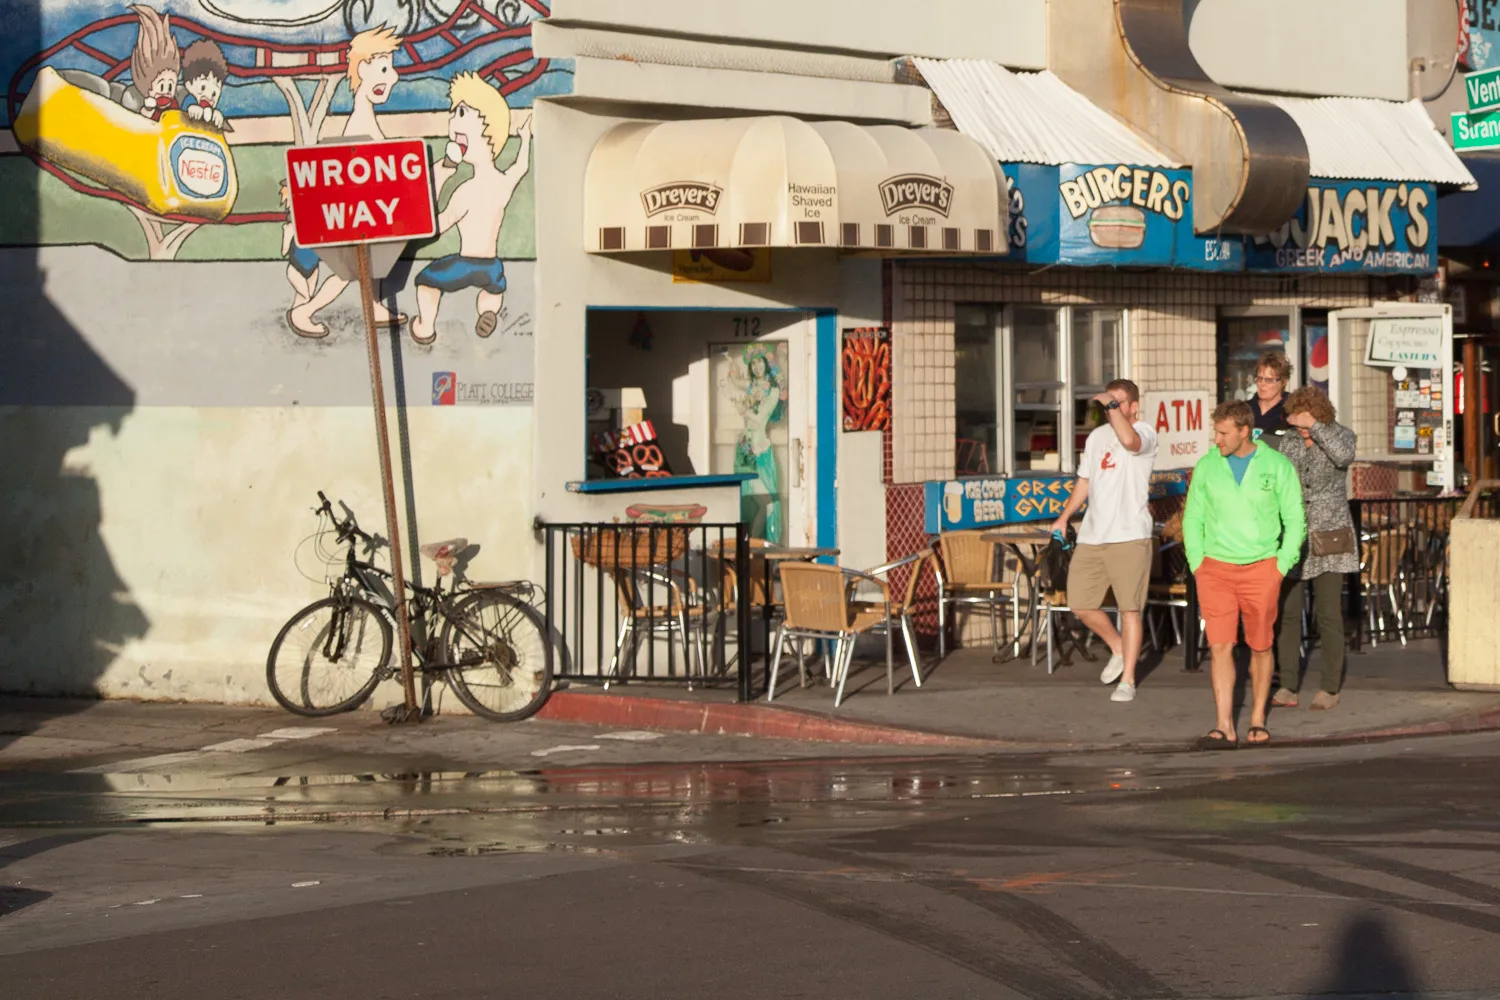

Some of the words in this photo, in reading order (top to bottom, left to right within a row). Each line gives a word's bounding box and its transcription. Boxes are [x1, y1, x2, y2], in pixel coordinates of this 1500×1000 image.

[292, 152, 422, 188] WRONG
[645, 183, 718, 212] Dreyer's
[788, 183, 836, 195] Hawaiian
[883, 179, 950, 210] Dreyer's
[1060, 164, 1189, 221] BURGERS
[792, 196, 832, 208] Shaved
[321, 197, 400, 231] WAY
[664, 214, 675, 222] Ice
[676, 213, 700, 222] Cream
[804, 208, 820, 219] Ice
[899, 215, 910, 225] Ice
[912, 214, 936, 225] Cream
[1254, 183, 1429, 251] JACK'S
[1275, 249, 1325, 268] GREEK
[1329, 248, 1353, 268] AND
[1363, 251, 1430, 269] AMERICAN
[732, 316, 761, 337] 712
[1389, 323, 1439, 337] Espresso
[457, 383, 487, 400] PLATT
[490, 382, 534, 400] COLLEGE
[1156, 399, 1202, 433] ATM
[1169, 441, 1198, 456] INSIDE
[1016, 480, 1074, 497] GREE
[1015, 497, 1087, 518] GYR
